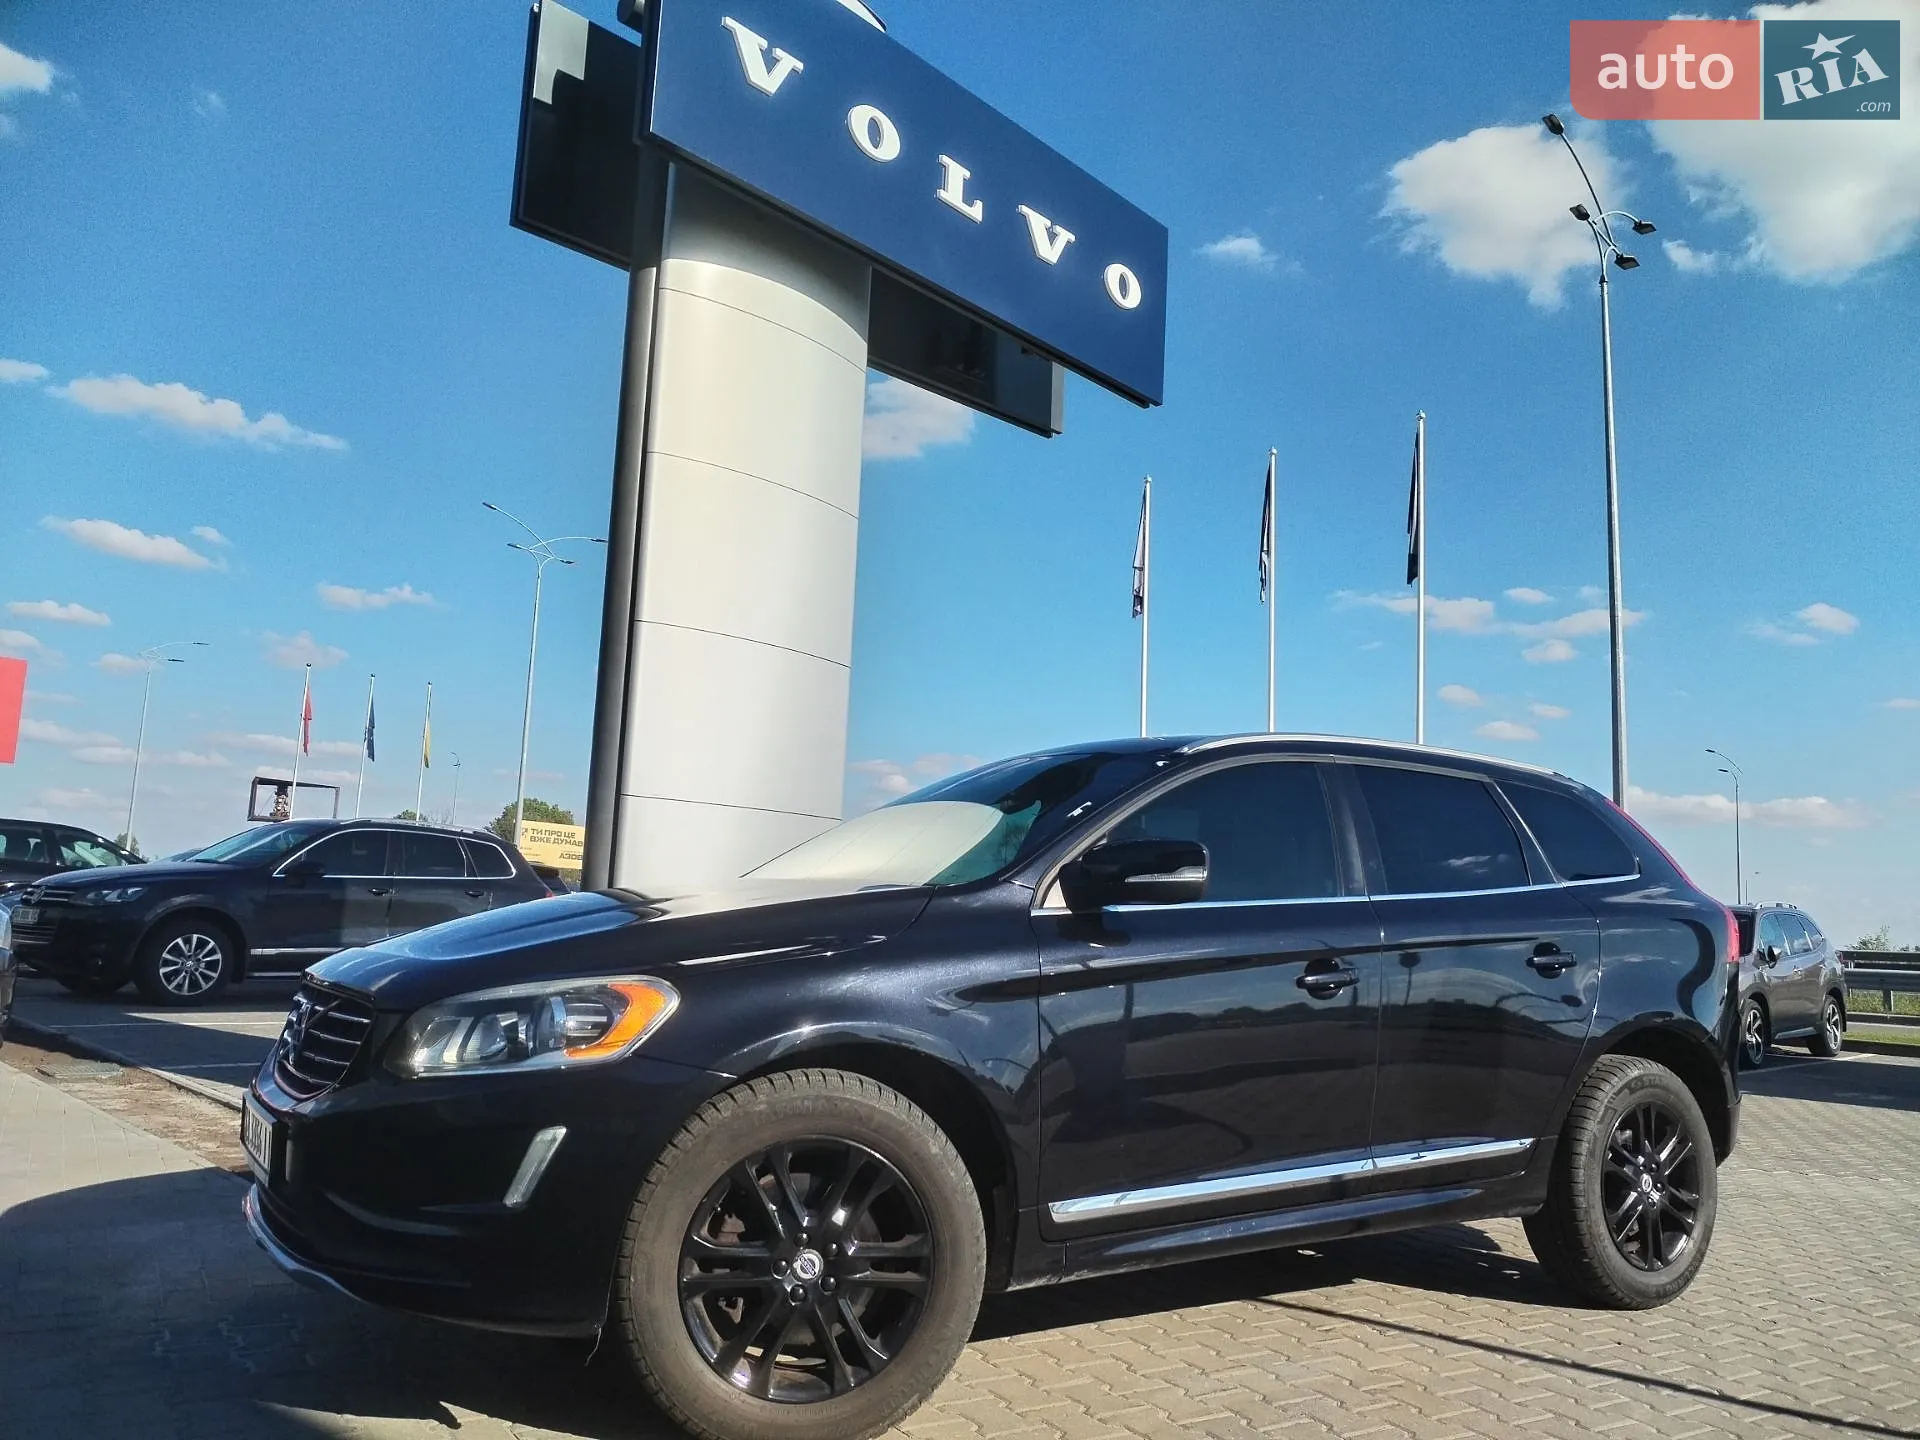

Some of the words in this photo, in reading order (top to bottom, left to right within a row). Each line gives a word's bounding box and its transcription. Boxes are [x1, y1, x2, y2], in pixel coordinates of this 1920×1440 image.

[721, 16, 1142, 310] VOLVO
[530, 828, 543, 836] ТИ
[544, 829, 563, 837] ПРО
[563, 831, 576, 839] ЦЕ
